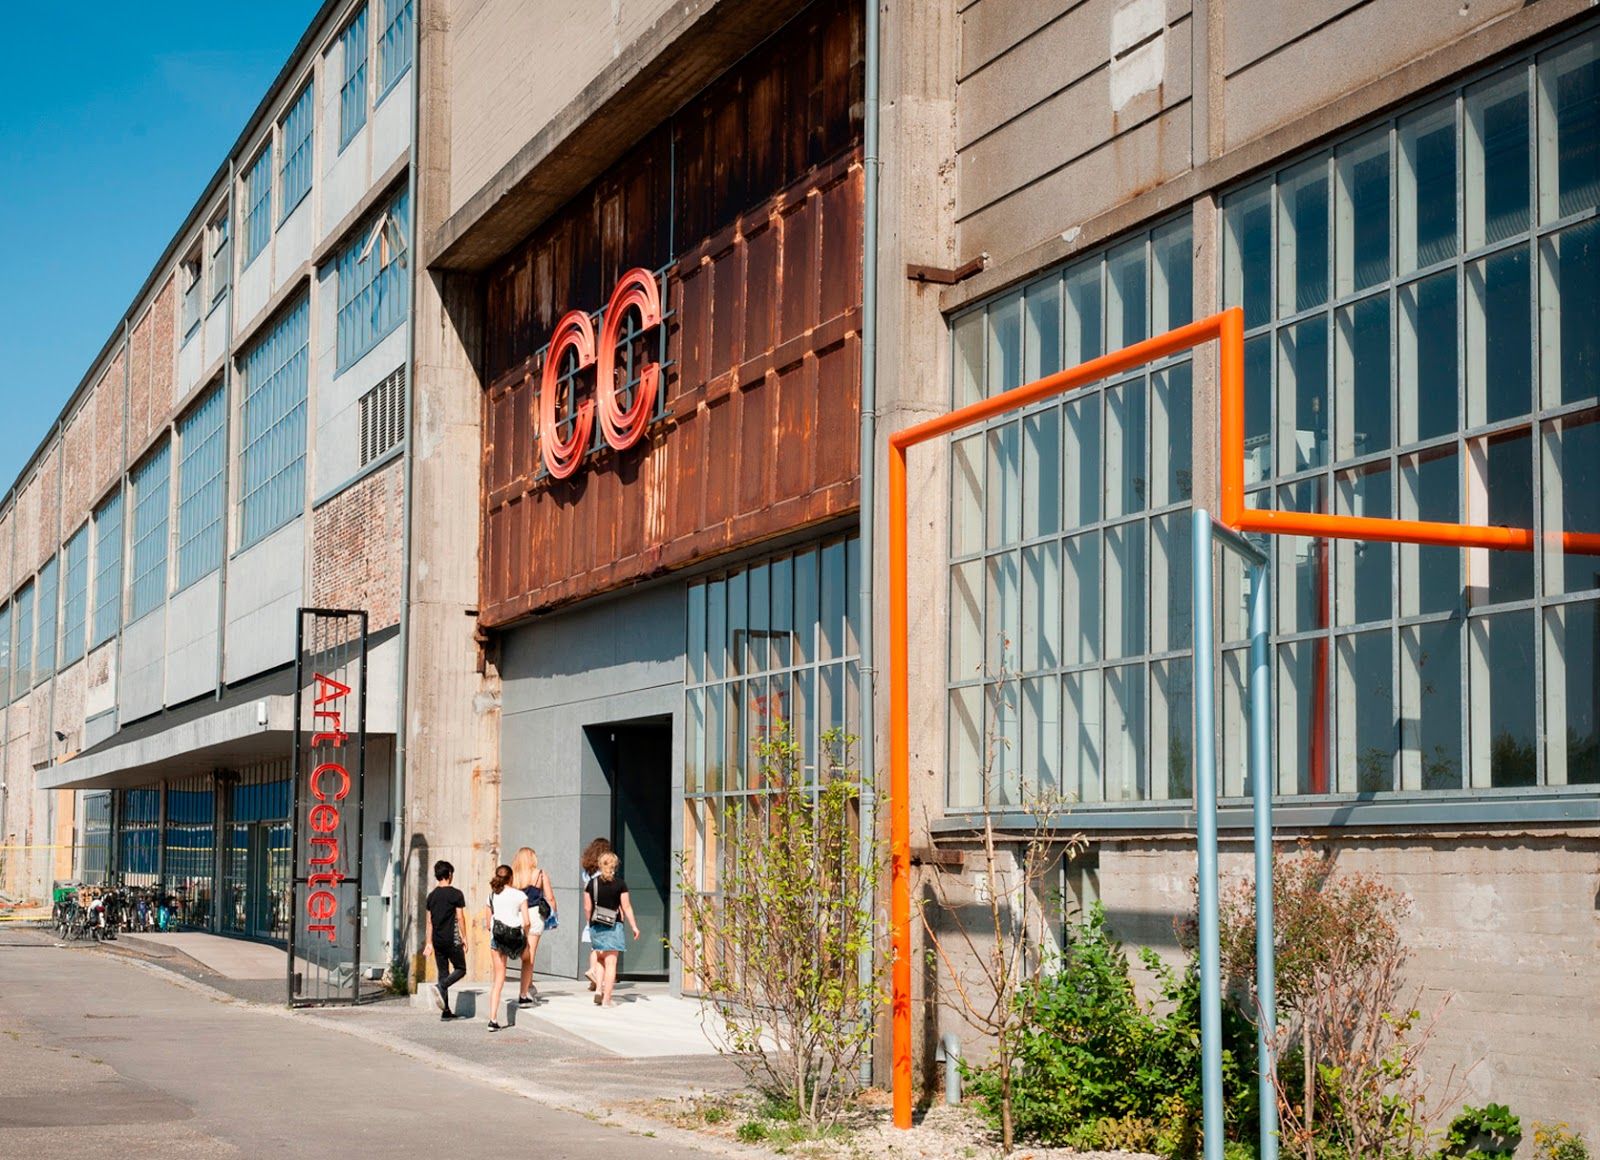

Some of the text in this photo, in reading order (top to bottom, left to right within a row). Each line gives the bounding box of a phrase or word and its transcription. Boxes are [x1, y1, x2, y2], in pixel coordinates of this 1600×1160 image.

[541, 267, 661, 479] CC
[306, 672, 351, 942] Art Center
